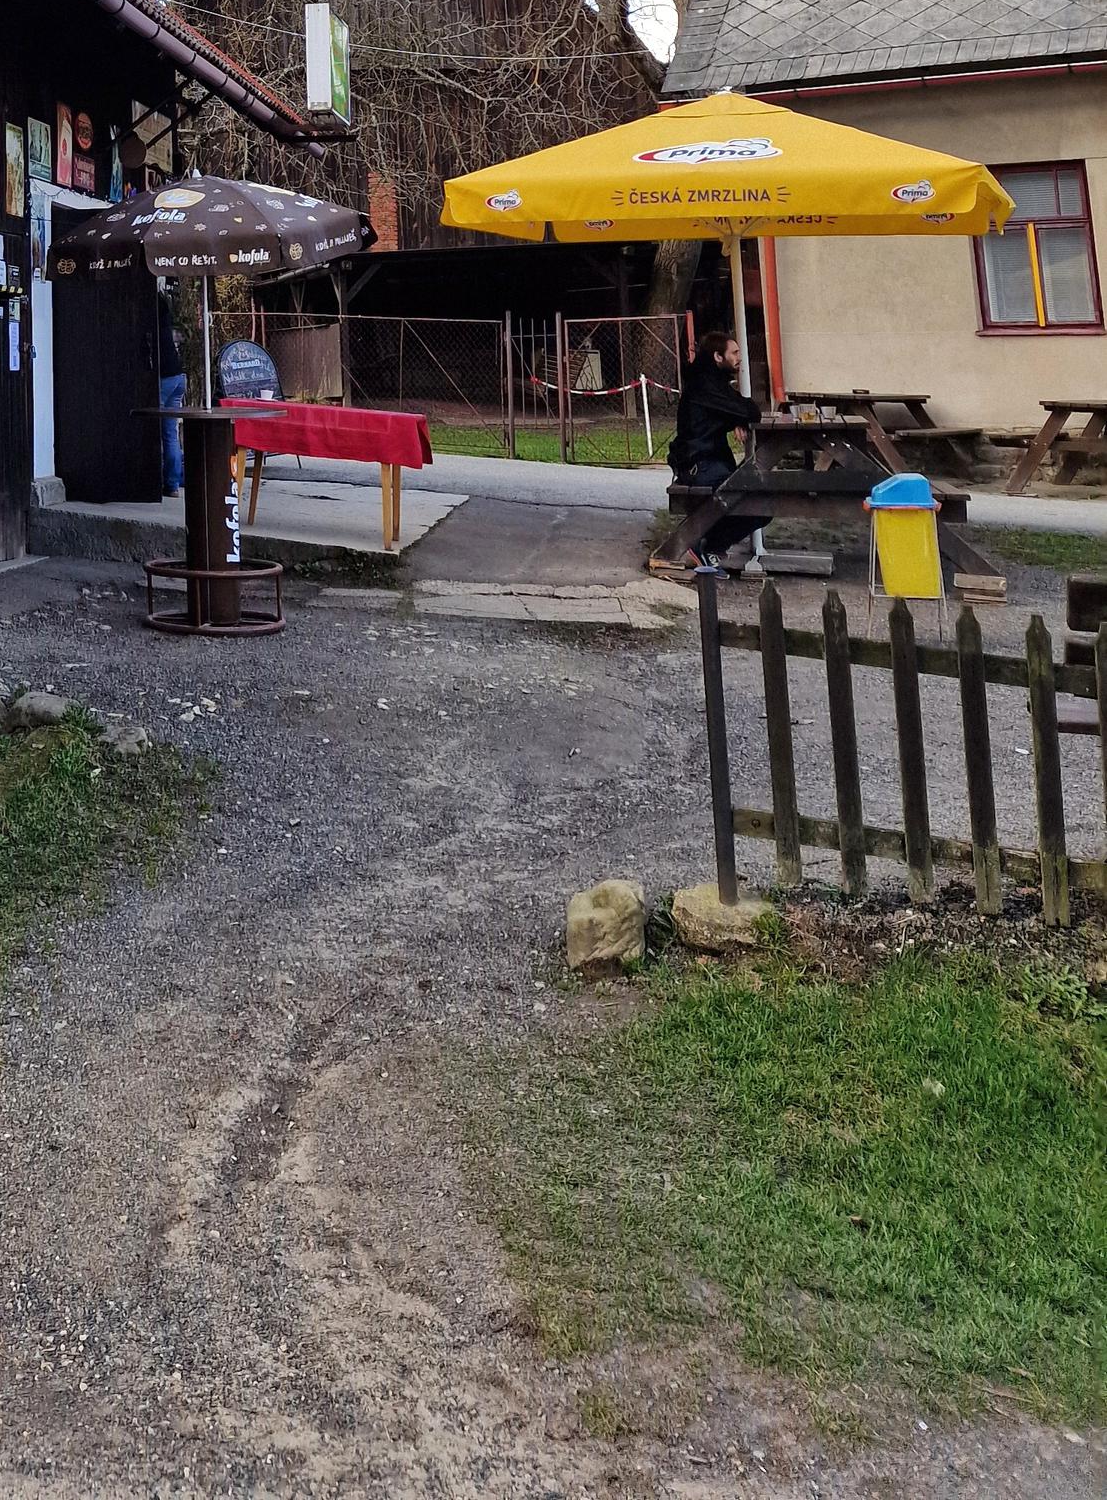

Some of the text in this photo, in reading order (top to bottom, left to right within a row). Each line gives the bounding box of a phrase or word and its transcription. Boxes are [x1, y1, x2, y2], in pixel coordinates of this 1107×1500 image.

[629, 187, 771, 204] ČESKÁ ZMRZLINA
[901, 188, 929, 197] Prima
[154, 254, 218, 267] NENÍ CO ŘEŠIT.
[237, 248, 271, 266] kofola
